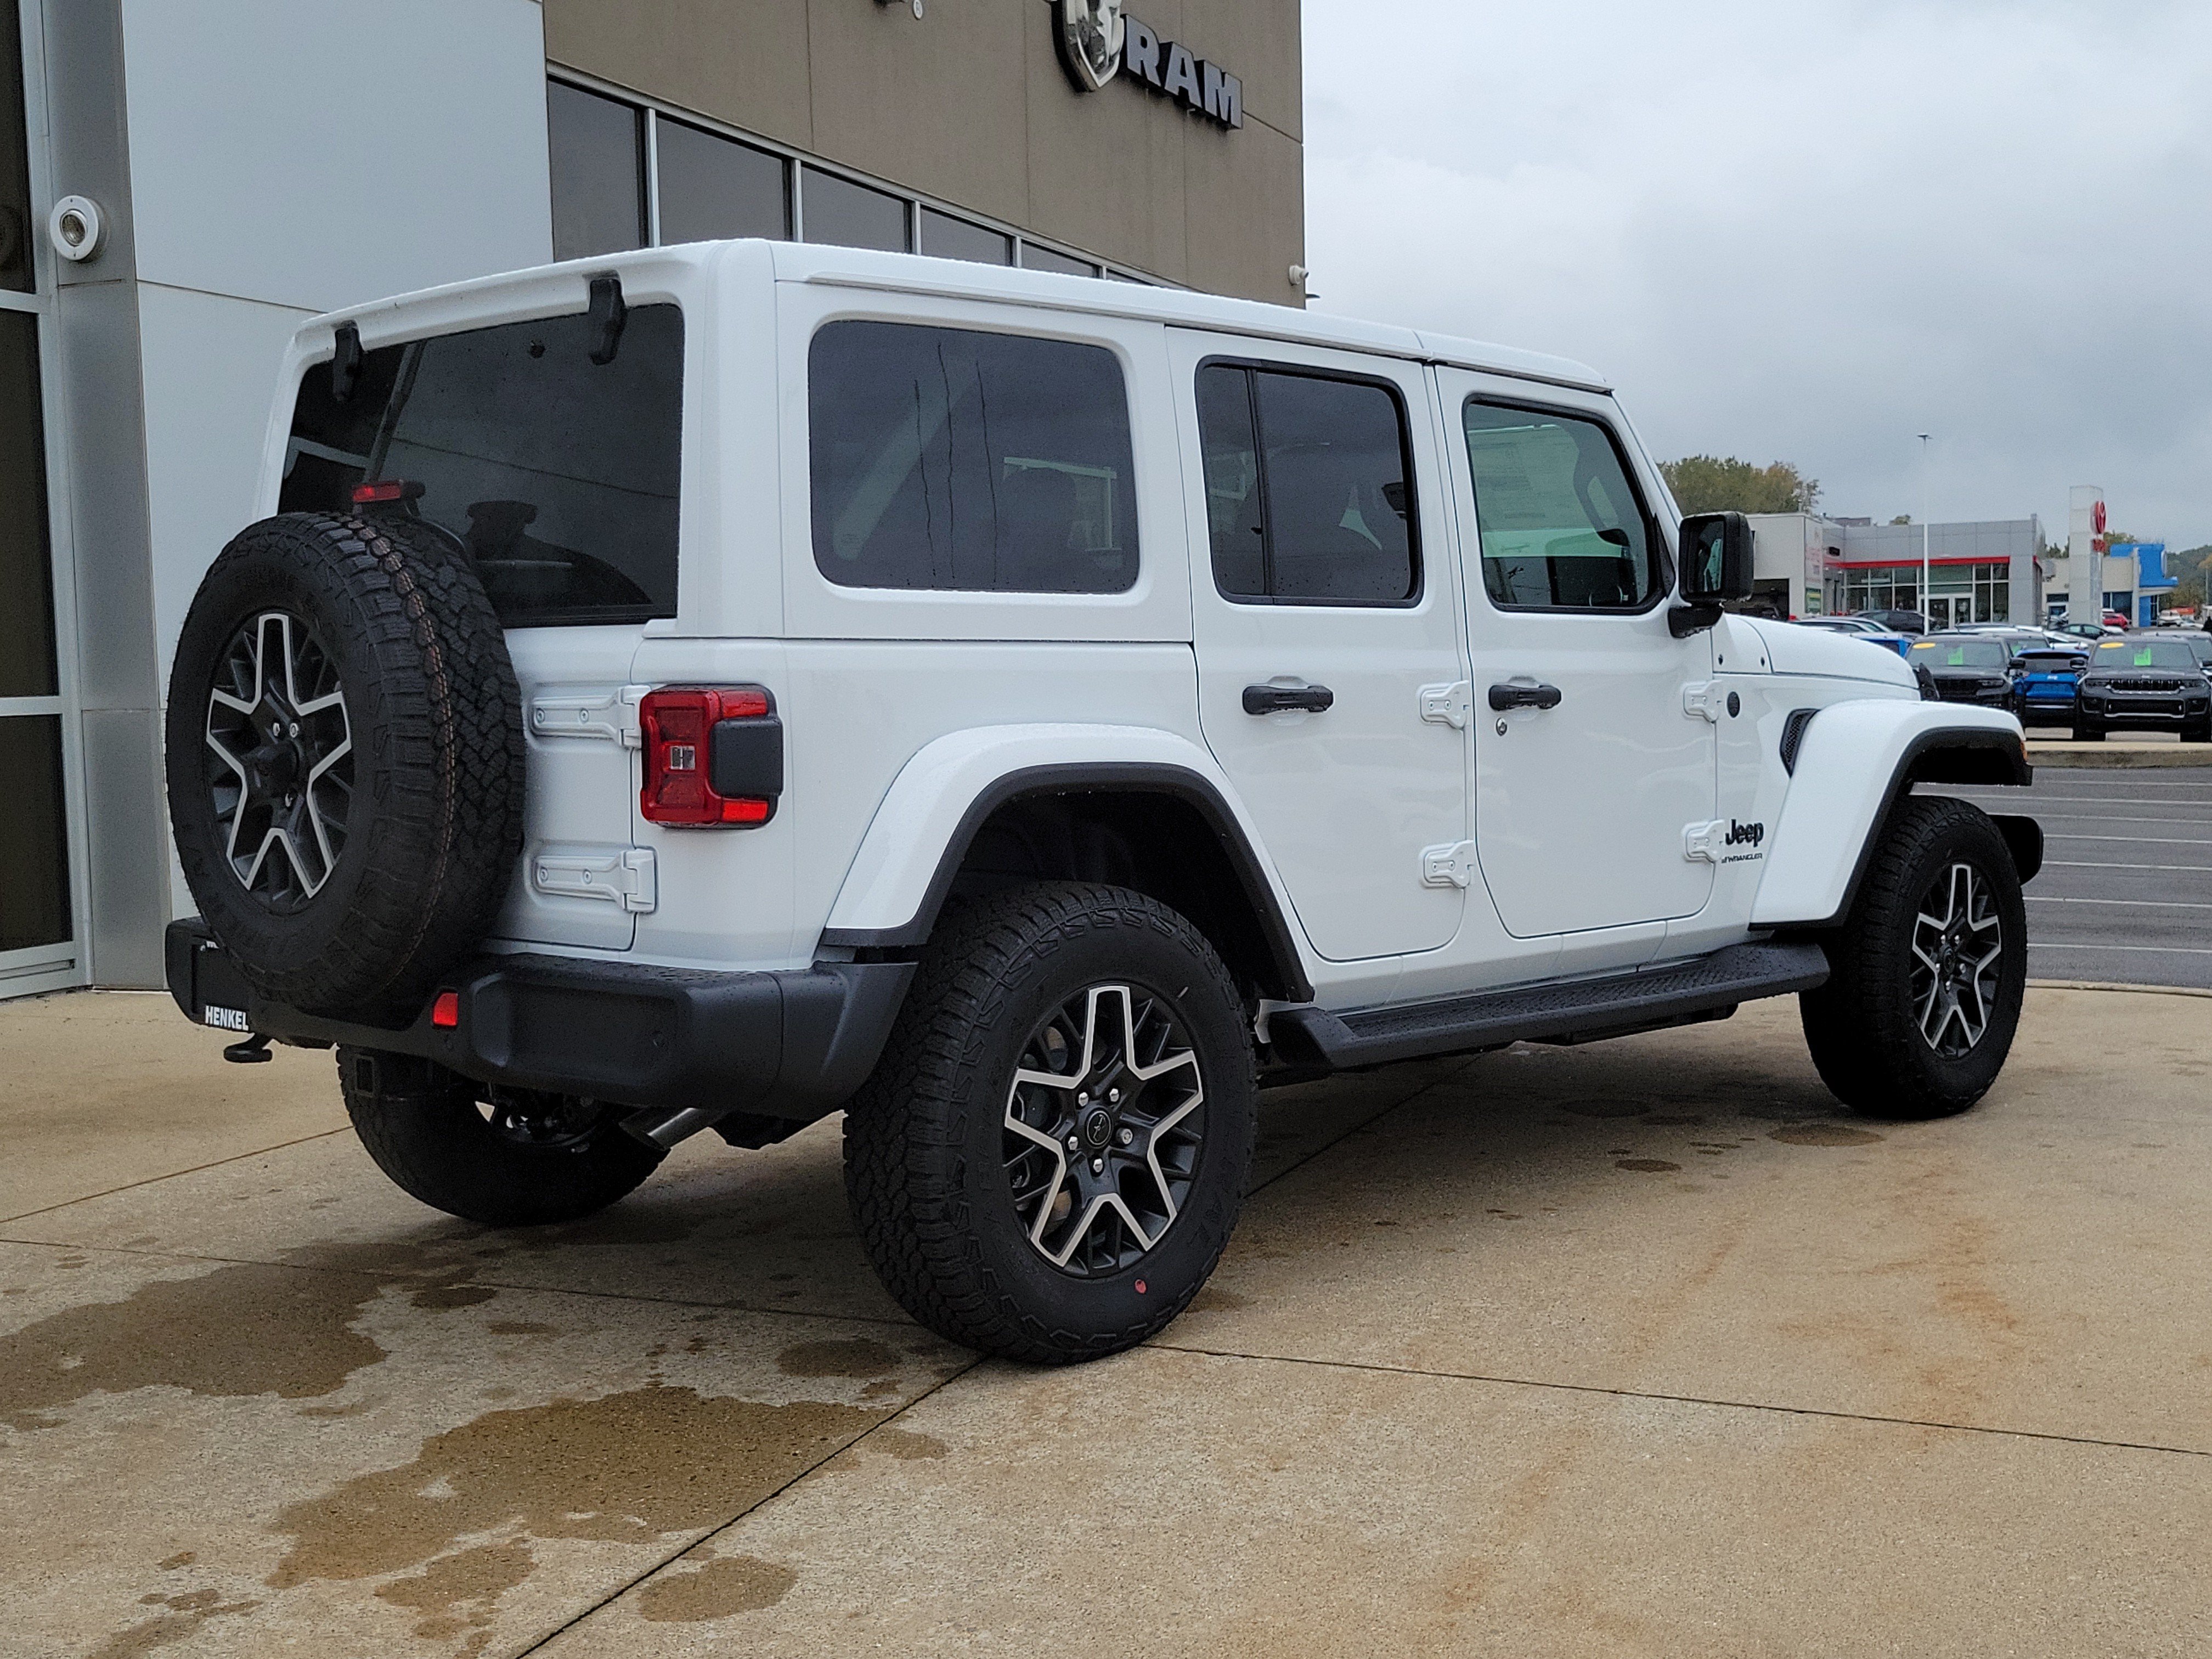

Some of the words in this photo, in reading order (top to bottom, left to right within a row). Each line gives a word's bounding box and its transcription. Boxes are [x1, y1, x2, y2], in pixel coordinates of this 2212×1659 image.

[1124, 14, 1242, 129] RAM
[1725, 819, 1764, 848] Jeep
[205, 1005, 249, 1031] HENKEL
